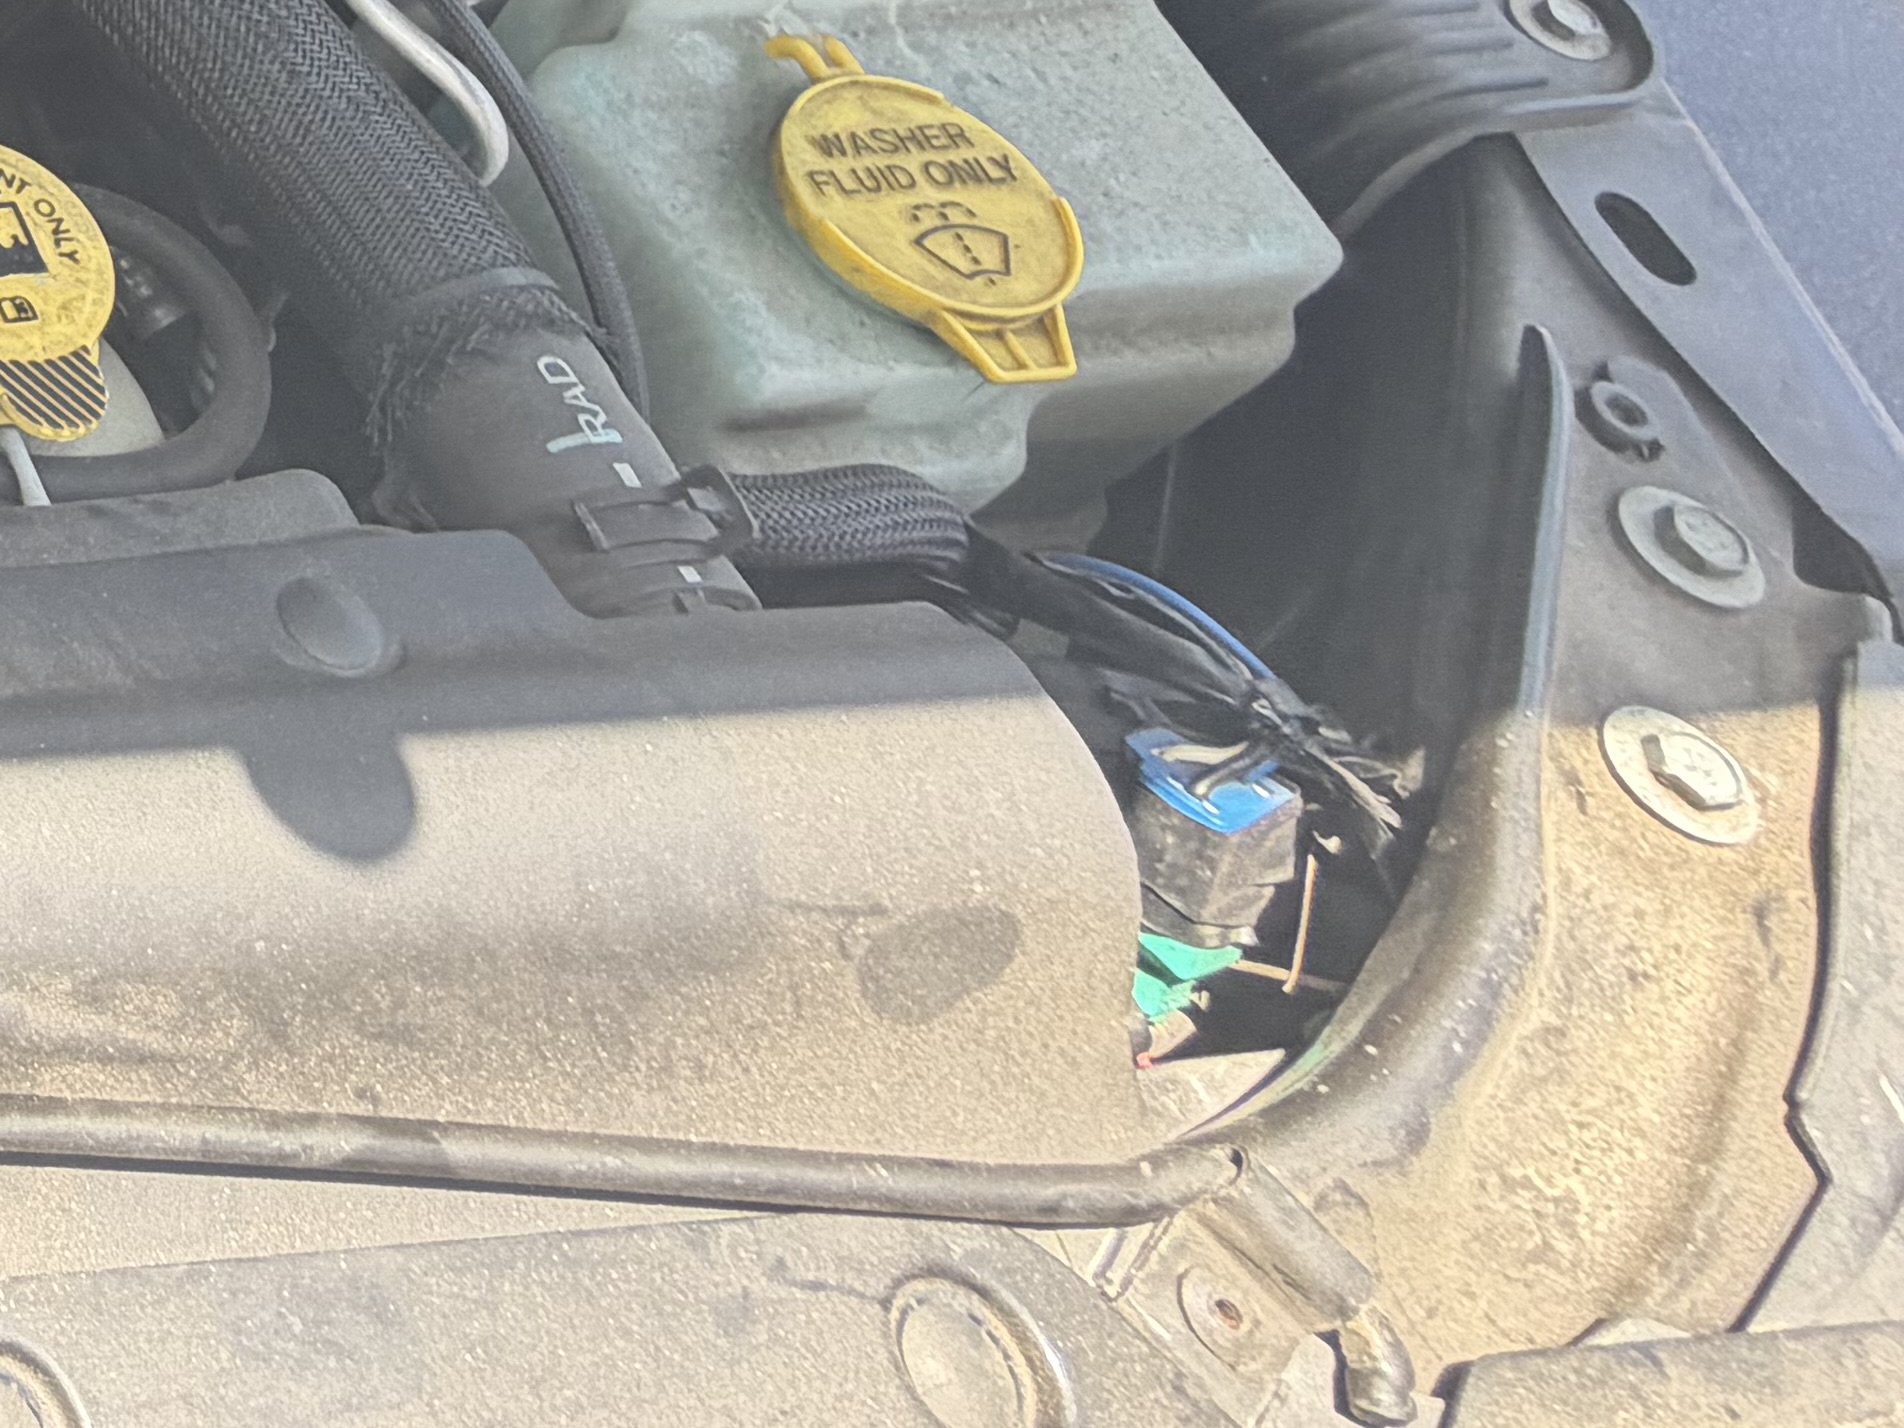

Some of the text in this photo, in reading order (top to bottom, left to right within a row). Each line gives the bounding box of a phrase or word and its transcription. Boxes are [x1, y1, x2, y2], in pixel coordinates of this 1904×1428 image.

[809, 121, 975, 159] WASHER
[805, 153, 1019, 198] FLUID ONLY
[33, 198, 82, 266] ONLY
